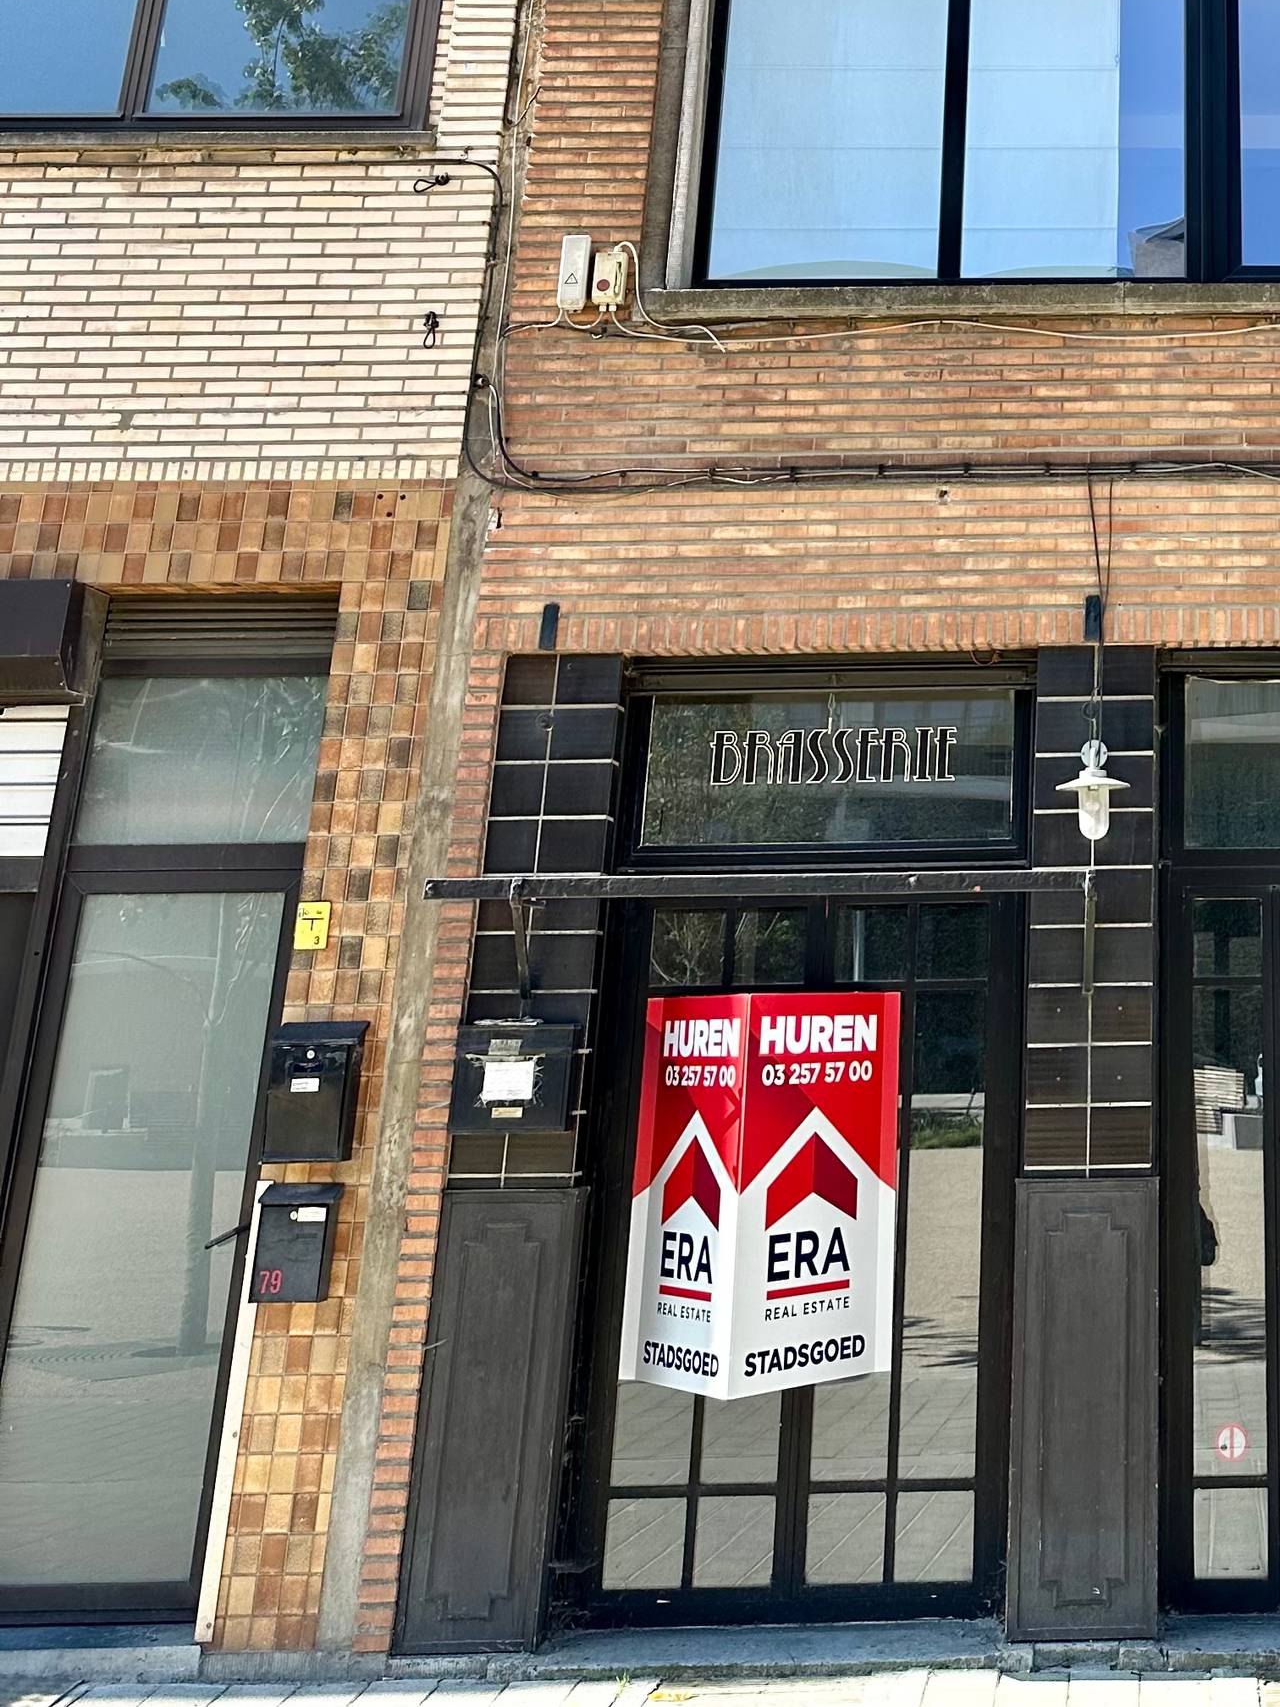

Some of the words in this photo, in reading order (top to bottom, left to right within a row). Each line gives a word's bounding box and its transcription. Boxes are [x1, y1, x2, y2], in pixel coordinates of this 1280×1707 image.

[710, 726, 957, 785] BRASSERIE
[663, 1018, 741, 1058] HUREN
[758, 1014, 878, 1055] HUREN
[665, 1065, 680, 1087] 03
[681, 1065, 702, 1087] 257
[703, 1065, 718, 1087] 57
[719, 1064, 736, 1088] 00
[761, 1063, 786, 1086] 03
[788, 1062, 821, 1085] 257
[824, 1061, 846, 1083] 57
[848, 1060, 873, 1082] 00
[660, 1230, 713, 1284] ERA
[767, 1226, 850, 1283] ERA
[259, 1269, 282, 1294] 79
[657, 1301, 678, 1318] REAL
[680, 1305, 711, 1323] ESTATE
[765, 1304, 798, 1321] REAL
[803, 1296, 850, 1316] ESTATE
[643, 1340, 719, 1378] STADSGOED
[744, 1334, 865, 1377] STADSGOED
